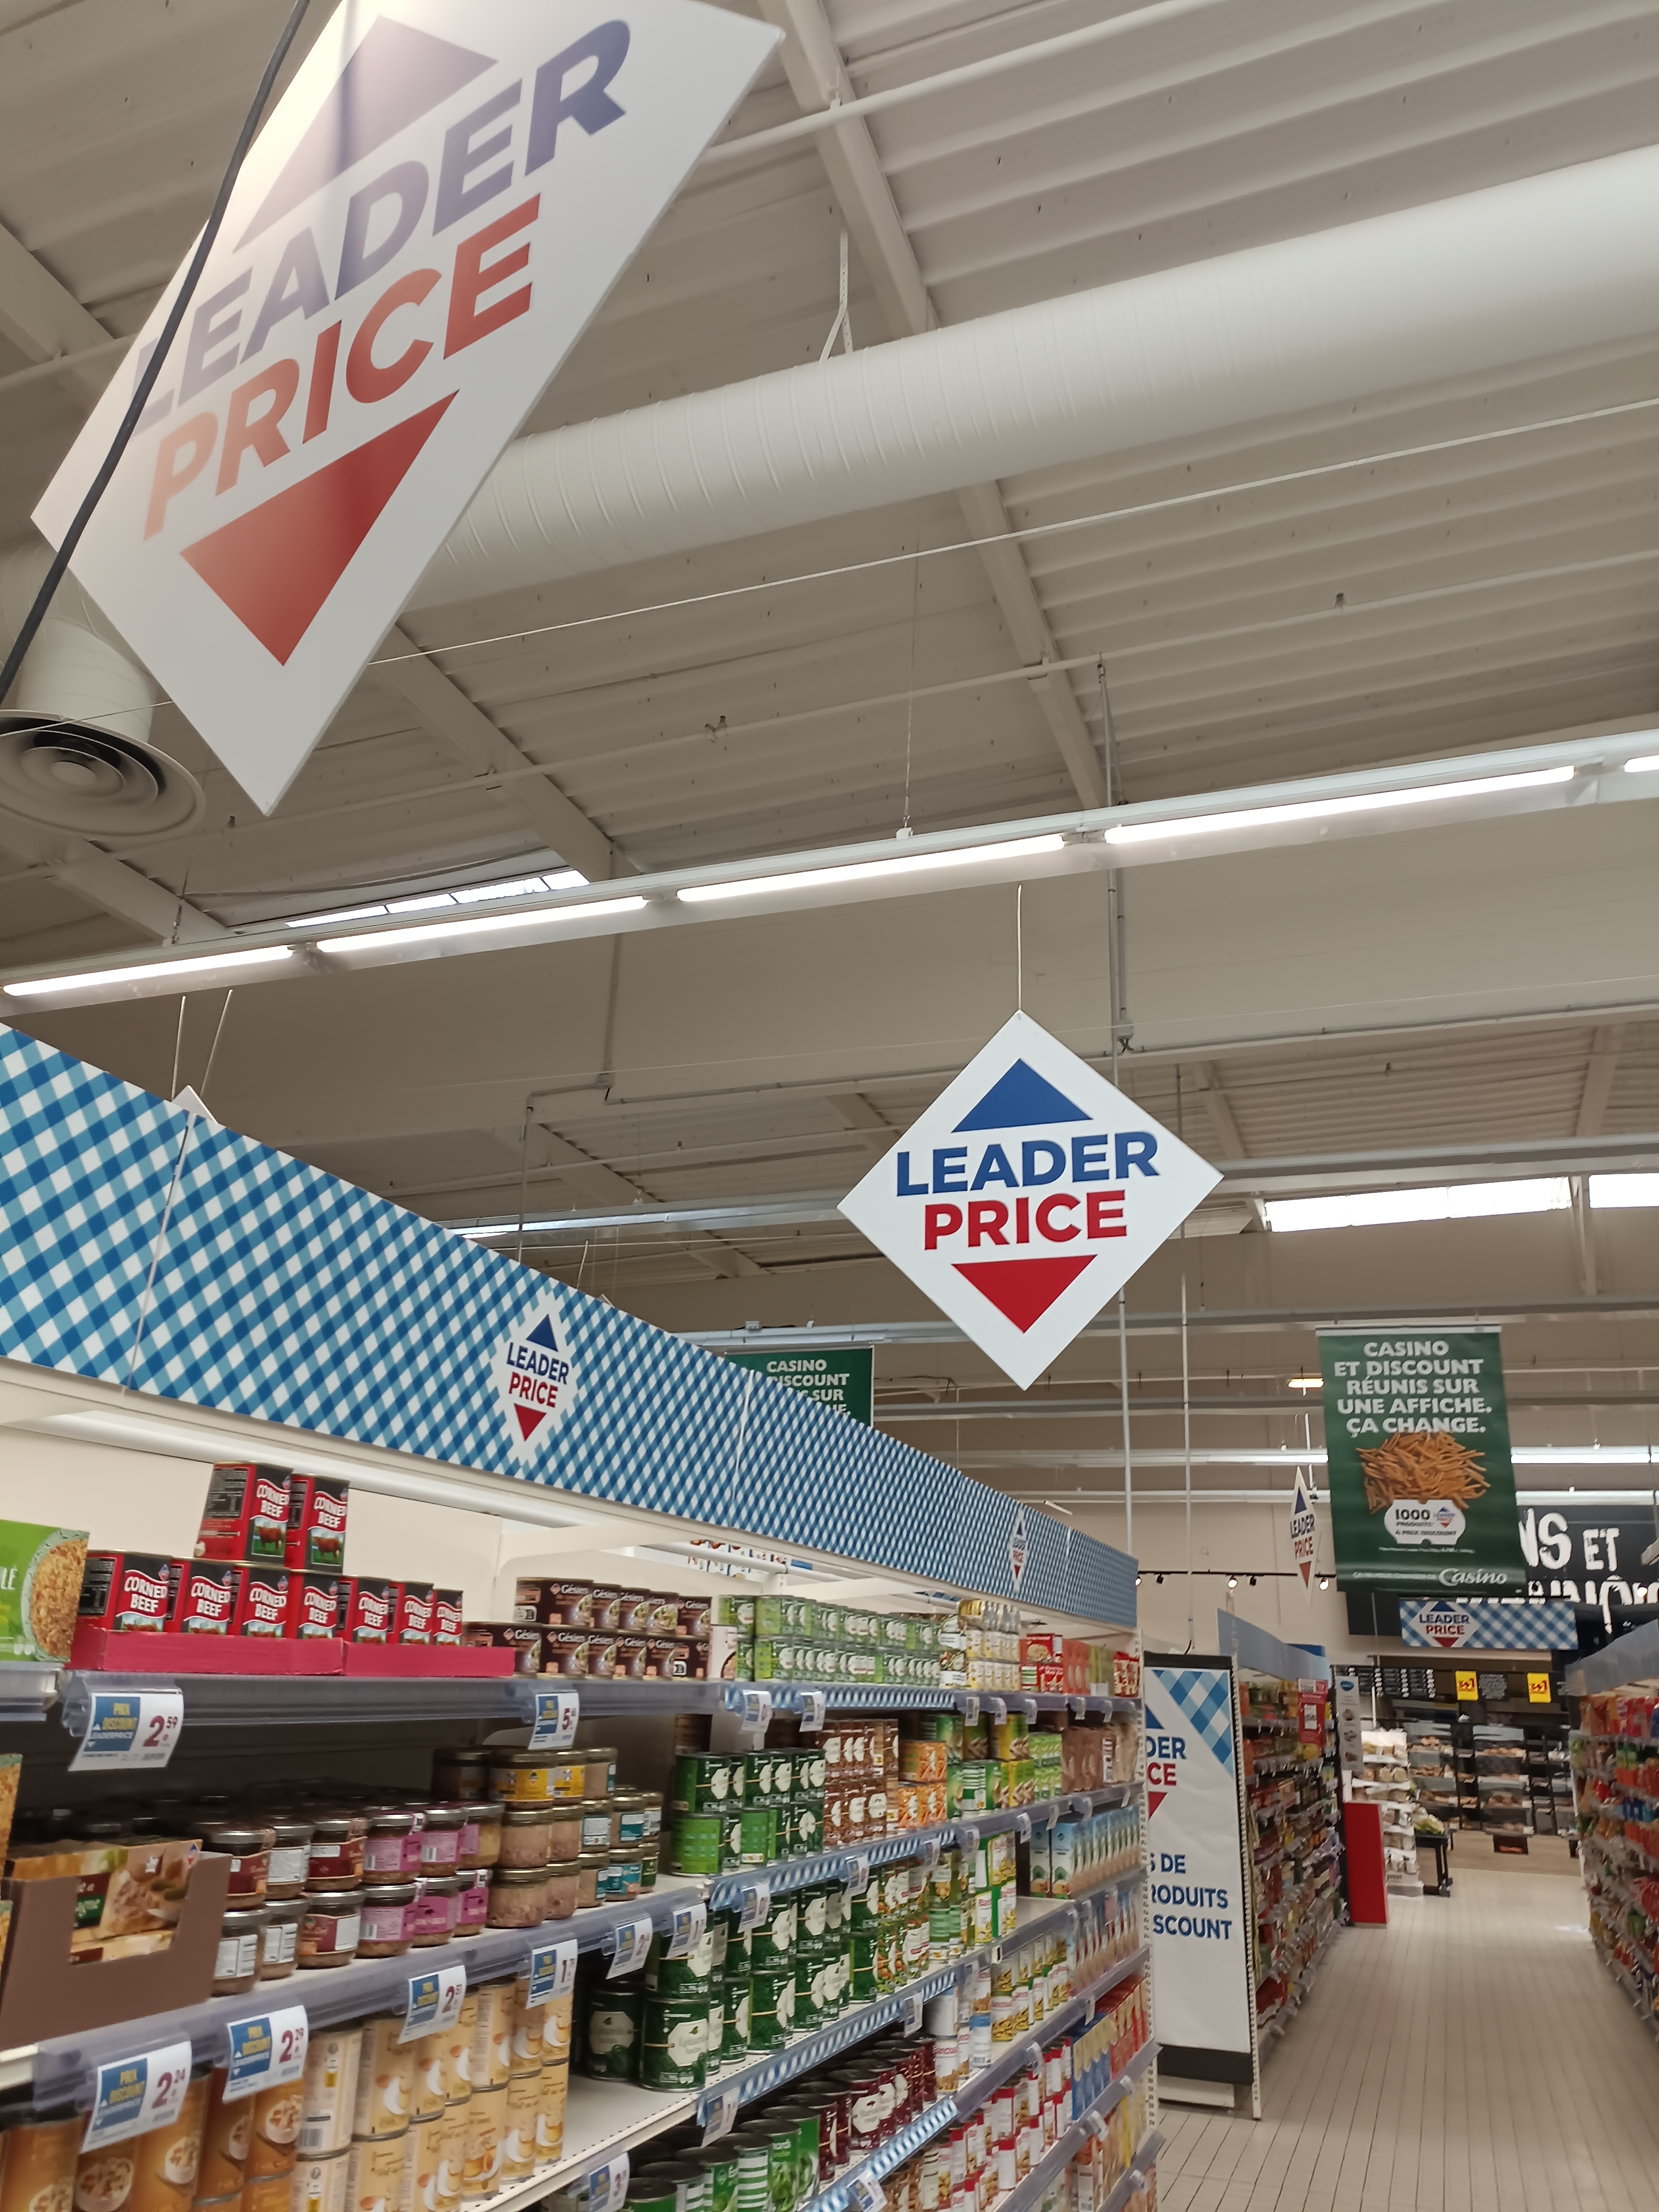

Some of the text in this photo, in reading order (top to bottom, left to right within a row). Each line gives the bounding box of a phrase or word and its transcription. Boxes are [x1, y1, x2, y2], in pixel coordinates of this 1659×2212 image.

[130, 19, 630, 439] LEADER
[143, 193, 541, 541] PRICE
[896, 1131, 1161, 1196] LEADER
[924, 1190, 1127, 1250] PRICE
[1363, 1340, 1449, 1357] CASINO
[506, 1342, 569, 1385] LEADER
[766, 1359, 827, 1373] CASINO
[1334, 1358, 1484, 1377] ET DISCOUNT
[508, 1371, 558, 1408] PRICE
[812, 1389, 844, 1401] SUR
[1346, 1375, 1480, 1395] RÉUNIS SUR
[1337, 1397, 1492, 1414] UNE AFFICHE.
[1346, 1417, 1487, 1438] ÇA CHANGE.
[260, 1500, 283, 1517] BEEF
[1395, 1509, 1431, 1520] 1000
[1290, 1513, 1315, 1539] LEADER
[1294, 1536, 1314, 1560] PRICE
[1582, 1527, 1620, 1572] ET
[124, 1576, 168, 1599] CORNED
[1439, 1568, 1508, 1587] Casino
[130, 1594, 159, 1613] BEEF
[191, 1582, 231, 1604] CORNED
[249, 1587, 287, 1608] CORNED
[196, 1599, 223, 1617] BEEF
[254, 1603, 278, 1621] BEEF
[1419, 1614, 1470, 1624] LEADER
[1426, 1624, 1466, 1635] PRICE
[143, 1715, 165, 1747] 2
[1147, 1762, 1177, 1786] CE
[1161, 1852, 1186, 1874] DE
[1153, 1914, 1232, 1940] SCOUNT
[279, 2030, 293, 2064] 2
[151, 2071, 172, 2109] 2
